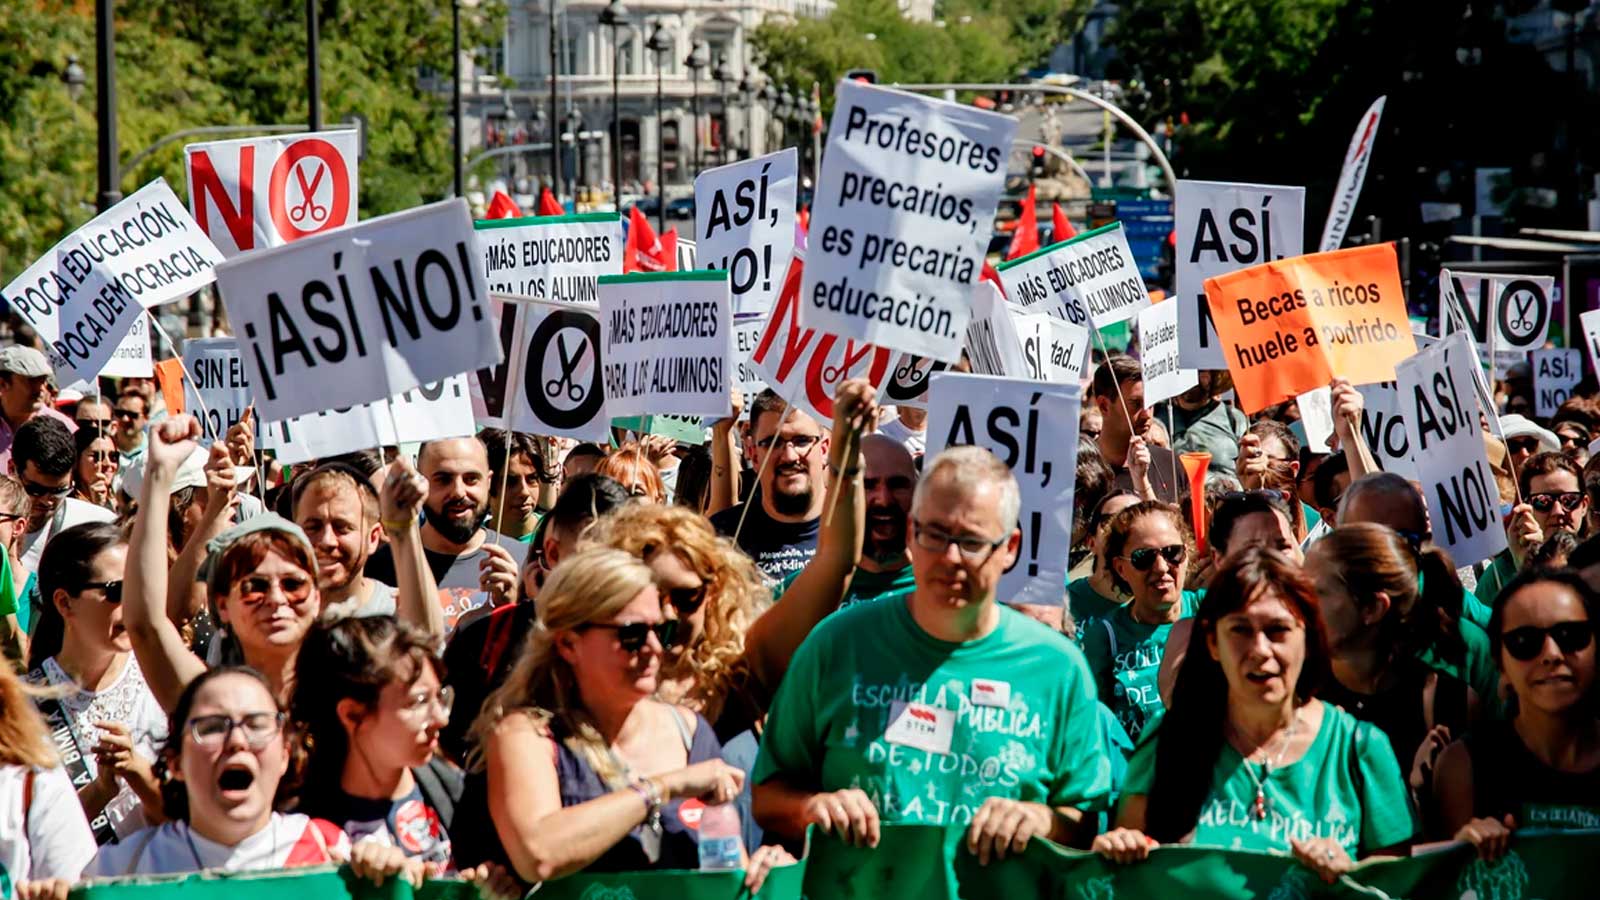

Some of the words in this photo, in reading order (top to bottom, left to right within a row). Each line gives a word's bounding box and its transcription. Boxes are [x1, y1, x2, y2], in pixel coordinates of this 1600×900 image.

[845, 105, 1000, 174] Profesores
[191, 139, 350, 251] NO
[706, 163, 778, 239] ASÍ,
[839, 171, 977, 233] precarios,
[13, 270, 76, 324] POCA
[63, 202, 187, 285] EDUCACIÓN,
[486, 235, 516, 278] ¡MÁS
[523, 235, 610, 267] EDUCADORES
[708, 245, 771, 295] O!
[822, 225, 852, 254] es
[860, 232, 974, 284] precaria
[1017, 273, 1047, 305] ¡MÁS
[1048, 245, 1125, 294] EDUCADORES
[53, 313, 108, 369] POCA
[93, 246, 215, 326] DEMOCRACIA.
[552, 276, 598, 302] ALUMN
[813, 277, 956, 339] educación.
[1086, 277, 1145, 317] ALUMNOS!
[1237, 287, 1306, 326] Becas
[1312, 287, 1324, 308] a
[1327, 280, 1381, 307] ricos
[1447, 278, 1548, 346] NO
[245, 252, 366, 400] ¡ASÍ
[370, 242, 483, 348] NO!
[608, 300, 635, 354] ¡MÁS
[640, 302, 718, 342] EDUCADORES
[738, 332, 751, 351] EL
[1234, 331, 1298, 369] huele
[1304, 324, 1318, 347] a
[194, 358, 223, 389] SIN
[604, 363, 627, 399] PARA
[632, 361, 649, 397] LOS
[650, 356, 723, 393] ALUMNOS!
[1051, 340, 1079, 372] tad...
[1539, 352, 1575, 381] ASÍ,
[193, 408, 221, 439] NO
[227, 408, 260, 437] HY
[1414, 349, 1473, 450] ASÍ,
[945, 393, 1052, 487] ASÍ,
[1361, 408, 1414, 461] NO
[1435, 461, 1495, 546] NO!
[869, 742, 905, 766] DE
